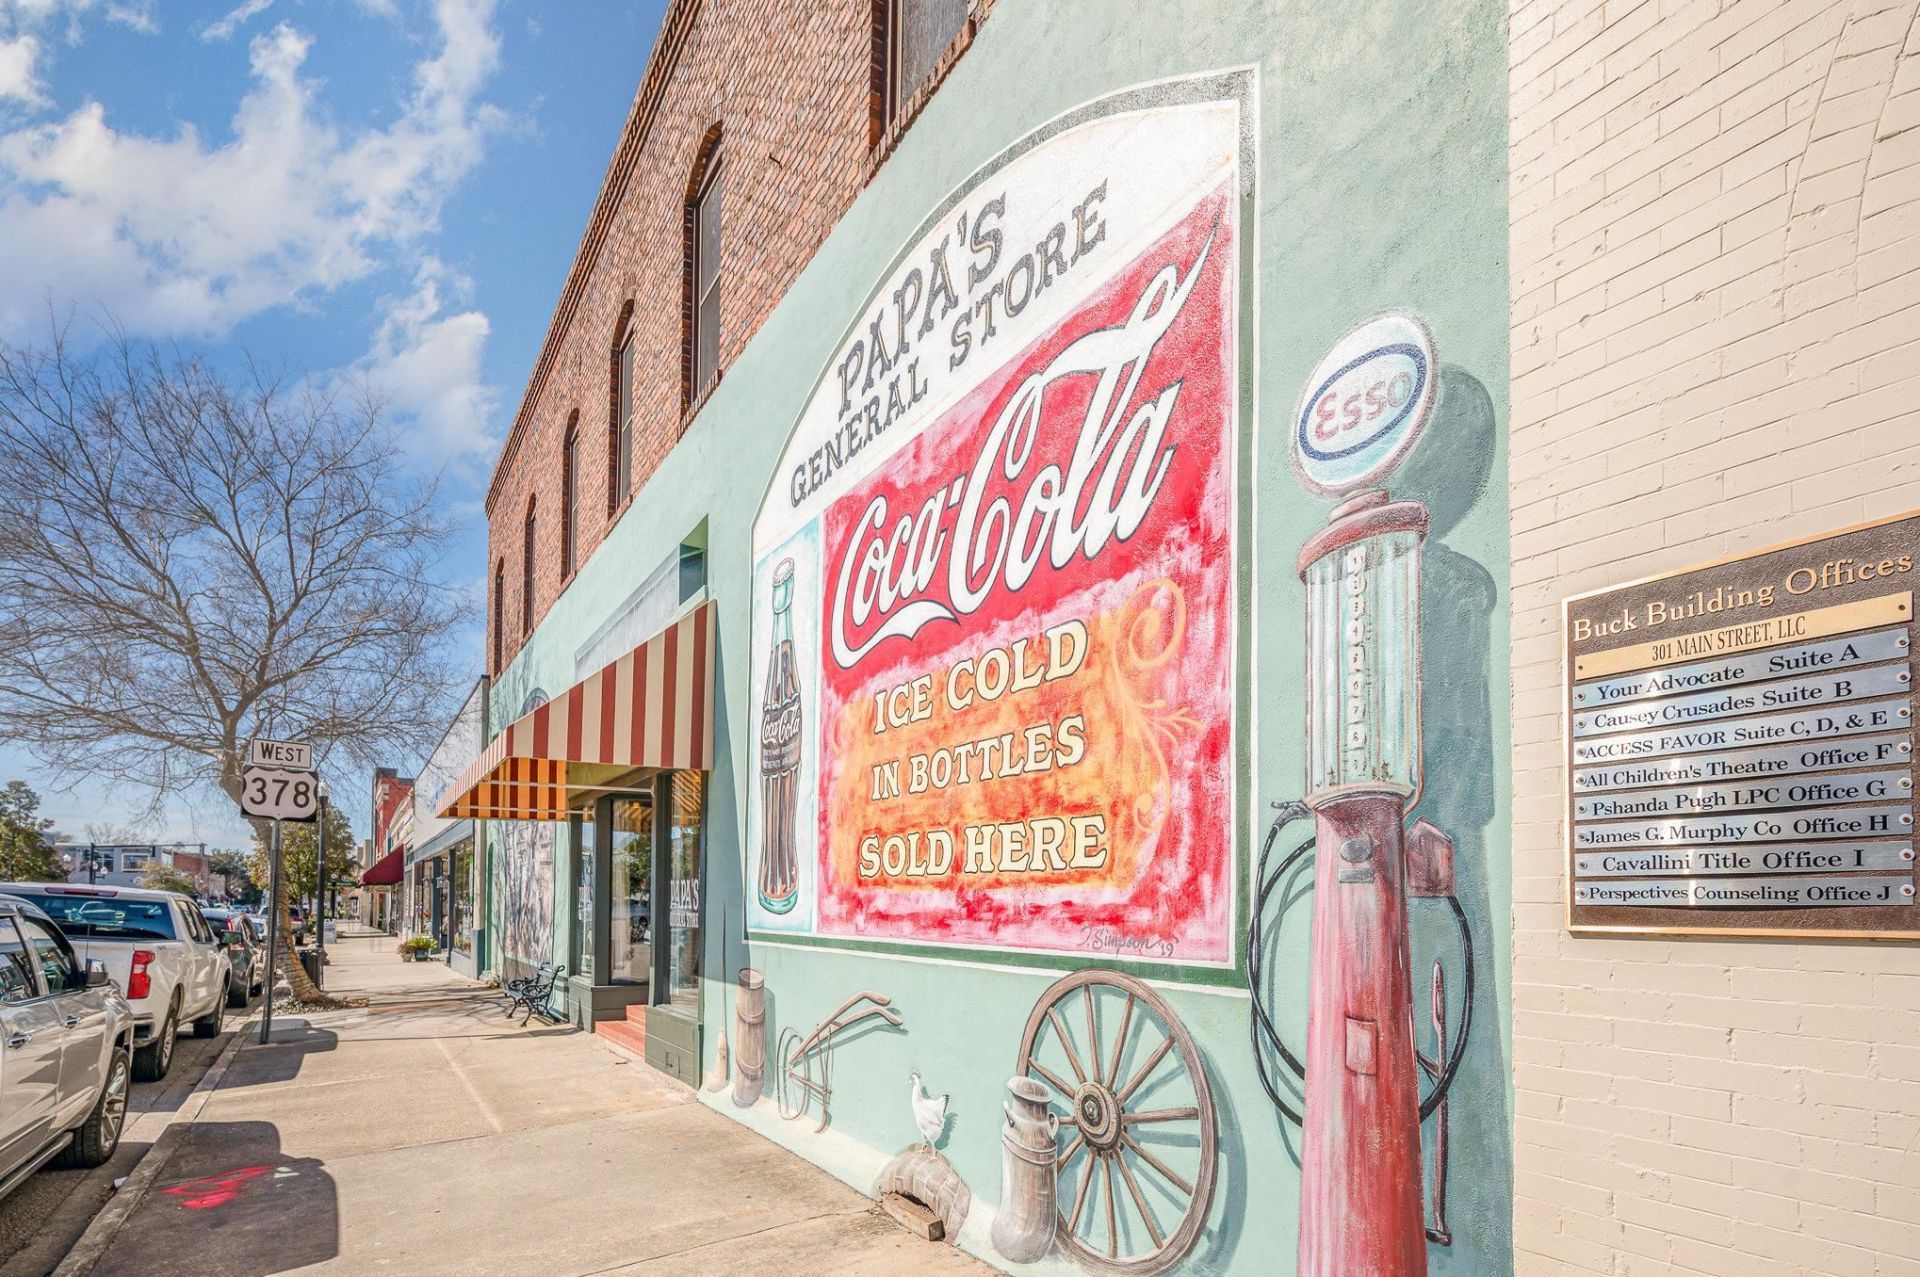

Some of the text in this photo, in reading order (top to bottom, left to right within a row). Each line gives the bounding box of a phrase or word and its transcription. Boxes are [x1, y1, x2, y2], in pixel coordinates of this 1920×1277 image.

[837, 191, 1007, 422] PAPA'S
[789, 178, 1108, 508] GENERAL STORE
[1313, 371, 1412, 441] ESSO
[831, 212, 1220, 669] Coca-Cola
[1573, 554, 1913, 642] Buck Building Offices
[1652, 615, 1806, 661] 301 MAIN STREET, LLC
[873, 618, 1089, 734] ICE COLD
[1596, 643, 1861, 701] Your Advocate Suite A
[762, 700, 800, 744] Coca-Cola
[1594, 680, 1853, 728] Causey Crusades Suite B
[260, 742, 304, 763] WEST
[871, 715, 1087, 800] IN BOTTLES
[1584, 710, 1888, 759] ACCESS FAVOR Suite C, D, & E
[1585, 743, 1893, 787] All Children's Theatre Office F
[249, 777, 311, 809] 378
[1592, 780, 1887, 816] Pshanda Pugh LPC Office G
[858, 814, 1107, 878] SOLD HERE
[1585, 814, 1889, 845] James G. Murphy Co Office H
[1602, 849, 1865, 872] Cavallini Title Office I
[1589, 885, 1892, 904] Perspectives Counseling Office J
